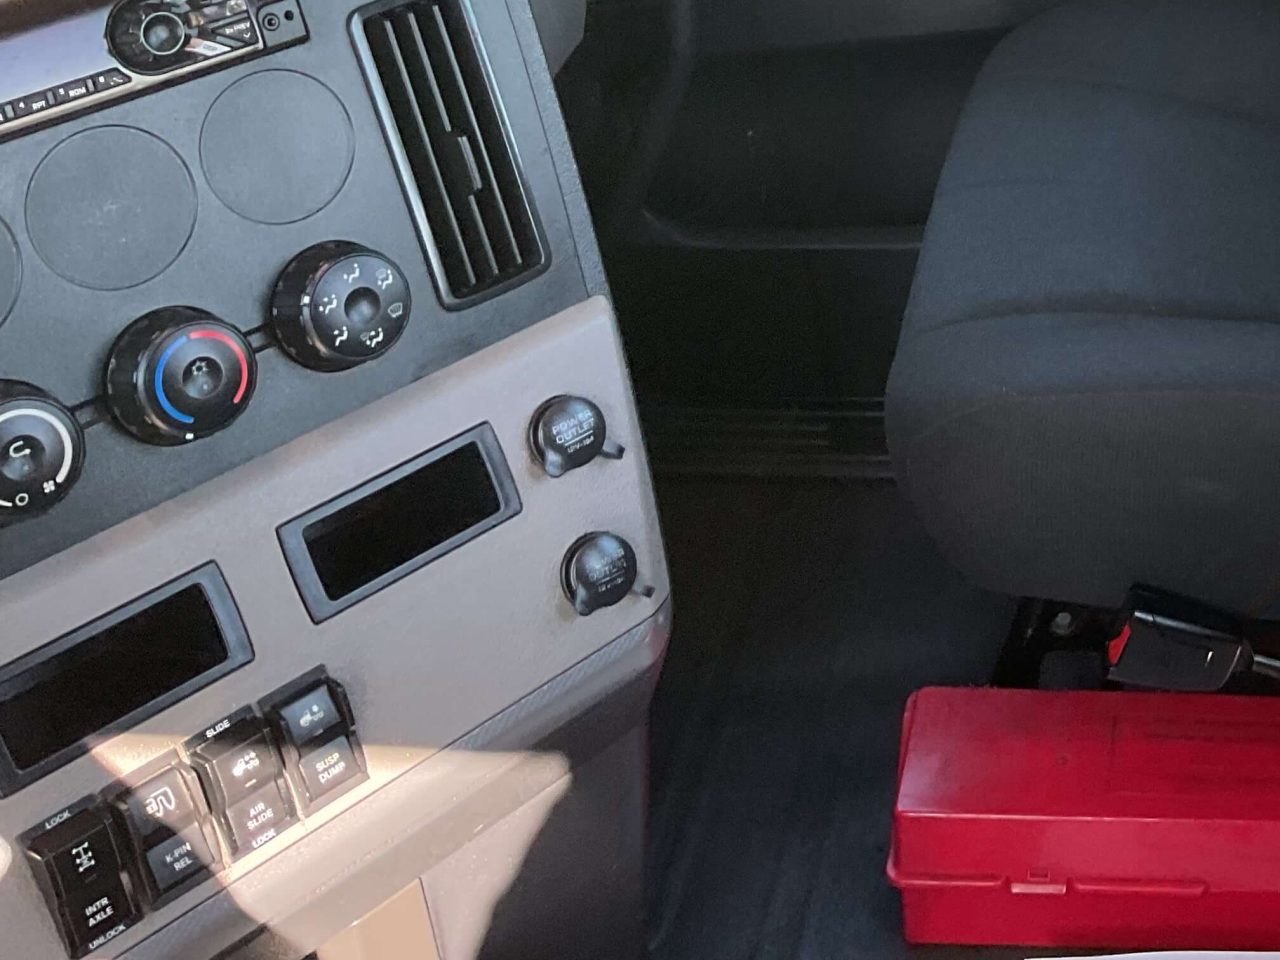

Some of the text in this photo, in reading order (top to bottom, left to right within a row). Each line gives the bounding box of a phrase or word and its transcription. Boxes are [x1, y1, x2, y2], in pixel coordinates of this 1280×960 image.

[552, 409, 593, 436] POWER
[556, 417, 594, 444] OUTLET
[205, 719, 231, 739] SLIDE
[315, 752, 340, 772] SUSP
[318, 761, 346, 784] DUMP
[45, 809, 72, 830] LOCK
[247, 808, 274, 831] SLIDE
[250, 802, 266, 817] AIR
[252, 828, 277, 849] LOCK
[165, 842, 192, 864] K-PIN
[173, 855, 194, 872] REL
[85, 896, 109, 917] INTR
[88, 905, 114, 928] AXLE
[88, 924, 127, 950] UNLOCK
